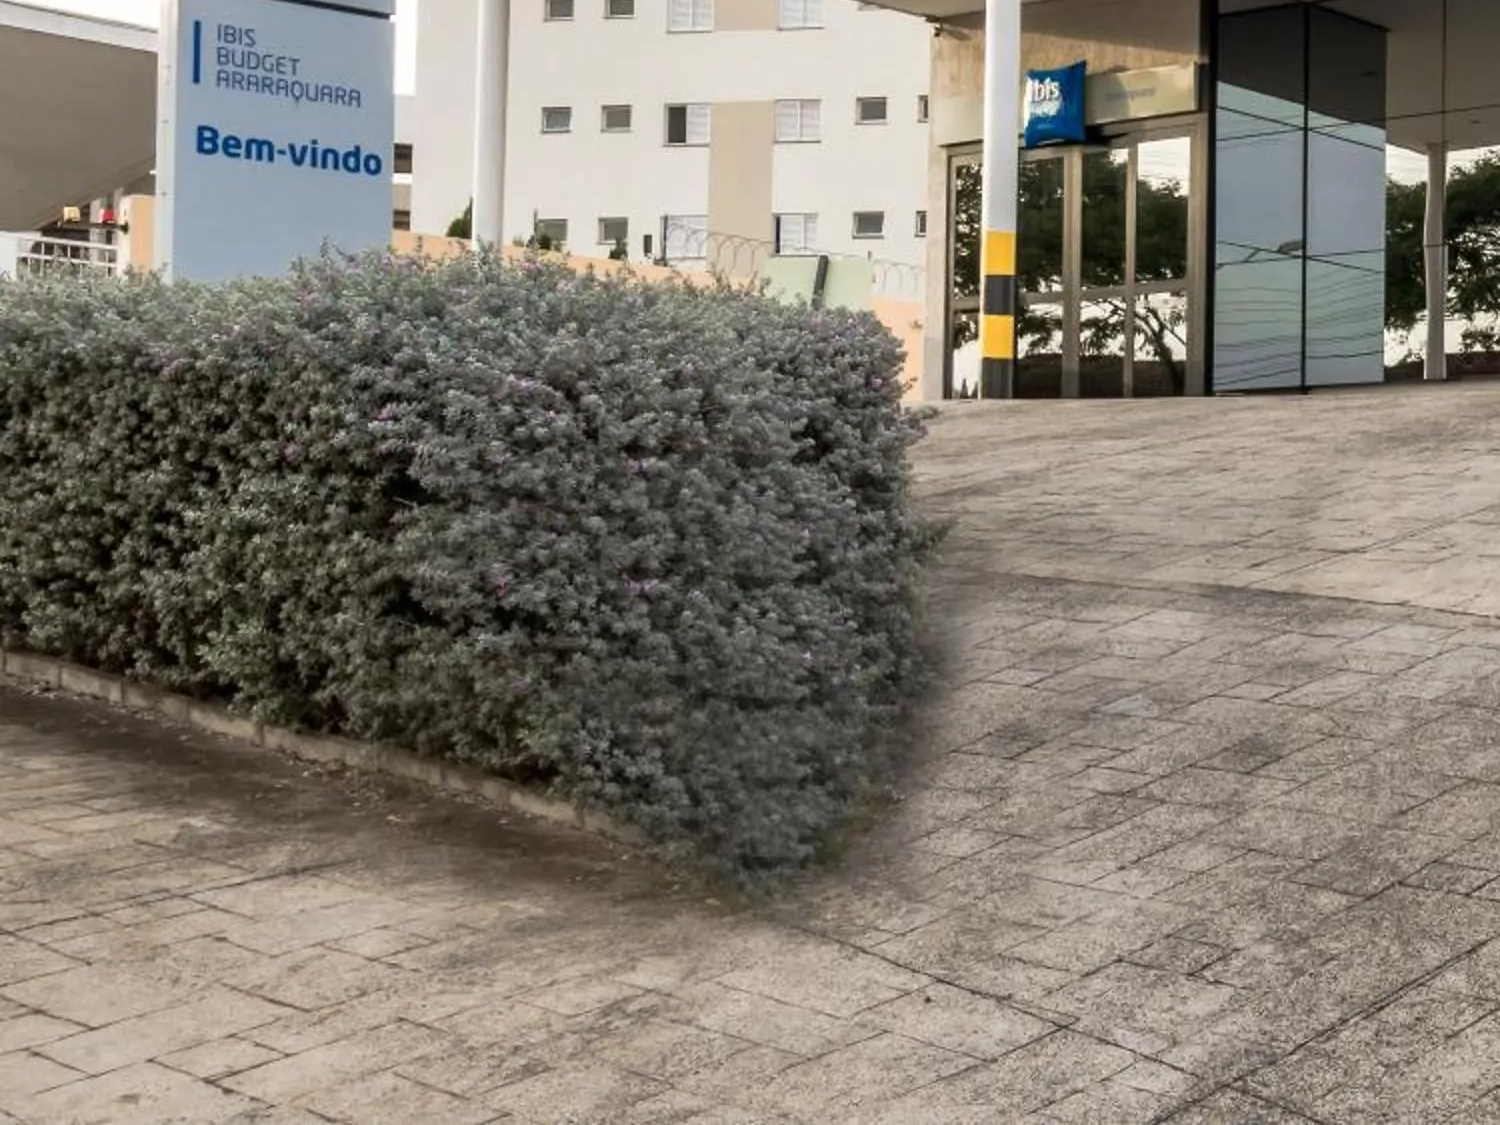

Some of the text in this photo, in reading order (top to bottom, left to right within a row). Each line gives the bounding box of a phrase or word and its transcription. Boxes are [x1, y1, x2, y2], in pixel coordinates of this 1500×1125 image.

[216, 24, 257, 48] IBIS
[216, 46, 301, 76] BUDGET
[215, 69, 362, 108] ARARAQUARA
[195, 124, 383, 176] Bem-vindo
